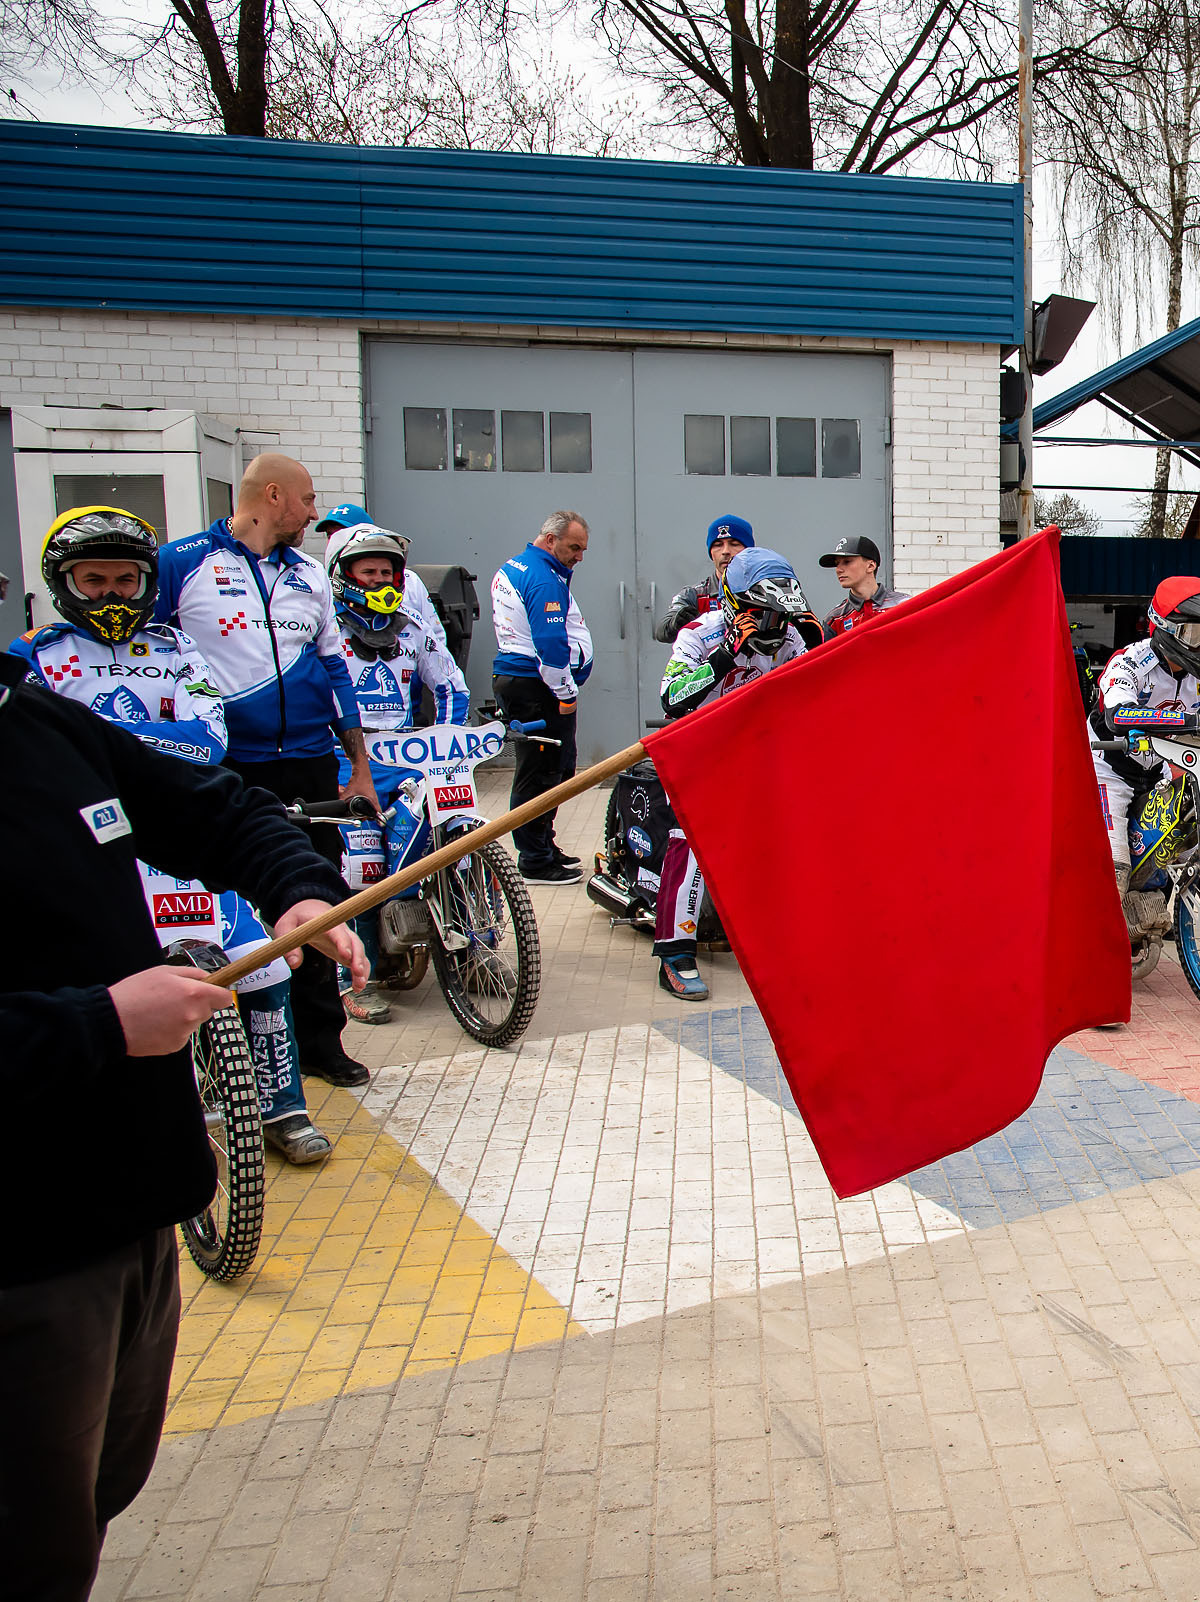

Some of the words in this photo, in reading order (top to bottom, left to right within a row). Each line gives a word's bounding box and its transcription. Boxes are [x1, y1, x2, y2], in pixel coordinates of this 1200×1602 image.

[724, 626, 740, 651] FOX
[91, 693, 109, 714] TAL
[1117, 708, 1153, 718] CARPETS
[1154, 709, 1162, 719] 4
[1162, 711, 1182, 719] LESS
[428, 765, 469, 776] NEXORIS
[437, 786, 472, 802] AMD
[156, 894, 213, 914] AMD
[159, 914, 211, 924] GROUP
[236, 971, 271, 987] OLSKA
[272, 1030, 293, 1090] zbita
